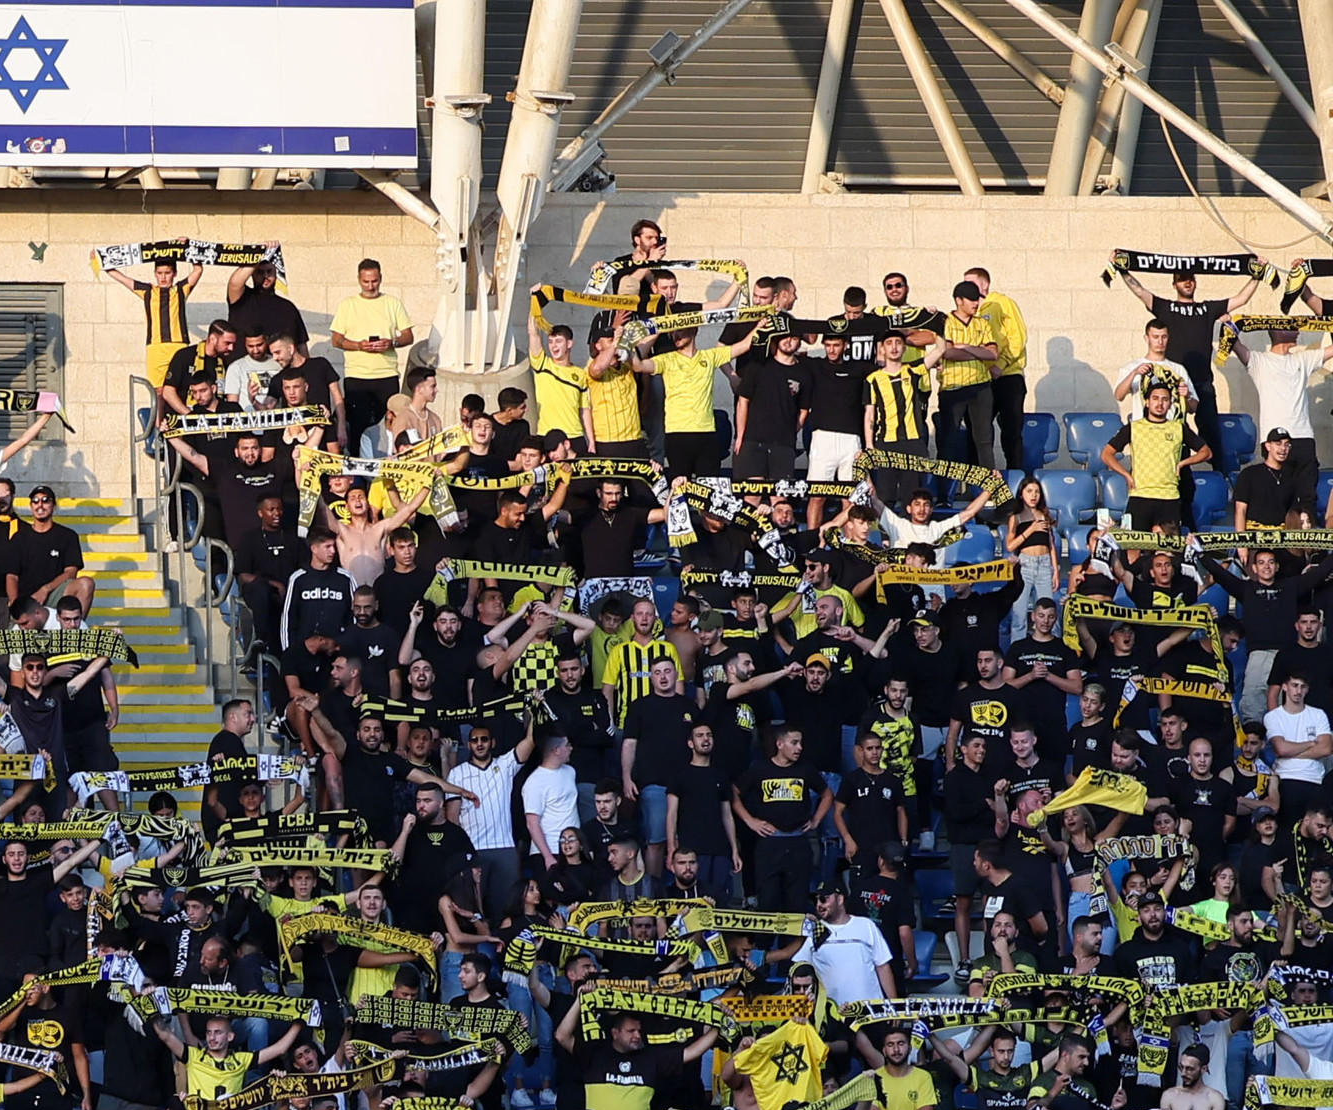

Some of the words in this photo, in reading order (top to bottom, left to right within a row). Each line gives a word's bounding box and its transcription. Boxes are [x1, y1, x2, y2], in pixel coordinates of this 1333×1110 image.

[143, 248, 185, 262] ירושלים
[219, 252, 264, 265] JERUSALEM
[1137, 256, 1196, 271] ירושלים
[1201, 257, 1242, 272] בית"ר
[182, 413, 206, 431] LA
[218, 406, 305, 430] FAMILIA
[732, 482, 774, 496] ירושלים
[808, 485, 855, 498] JERUSALEM
[753, 576, 802, 587] JERUSALEM
[1081, 602, 1149, 619] ירושלים
[1156, 606, 1210, 622] בית"ר
[1153, 680, 1217, 697] ירושלים
[278, 814, 315, 828] FCBJ
[39, 822, 105, 836] JERUSALEM
[250, 849, 319, 865] ירושלים
[325, 850, 374, 865] בית"ר
[714, 913, 774, 927] ירושלים
[600, 989, 713, 1023] FAMILIA
[904, 999, 995, 1020] FAMILIA
[1269, 1084, 1318, 1101] ירושלים
